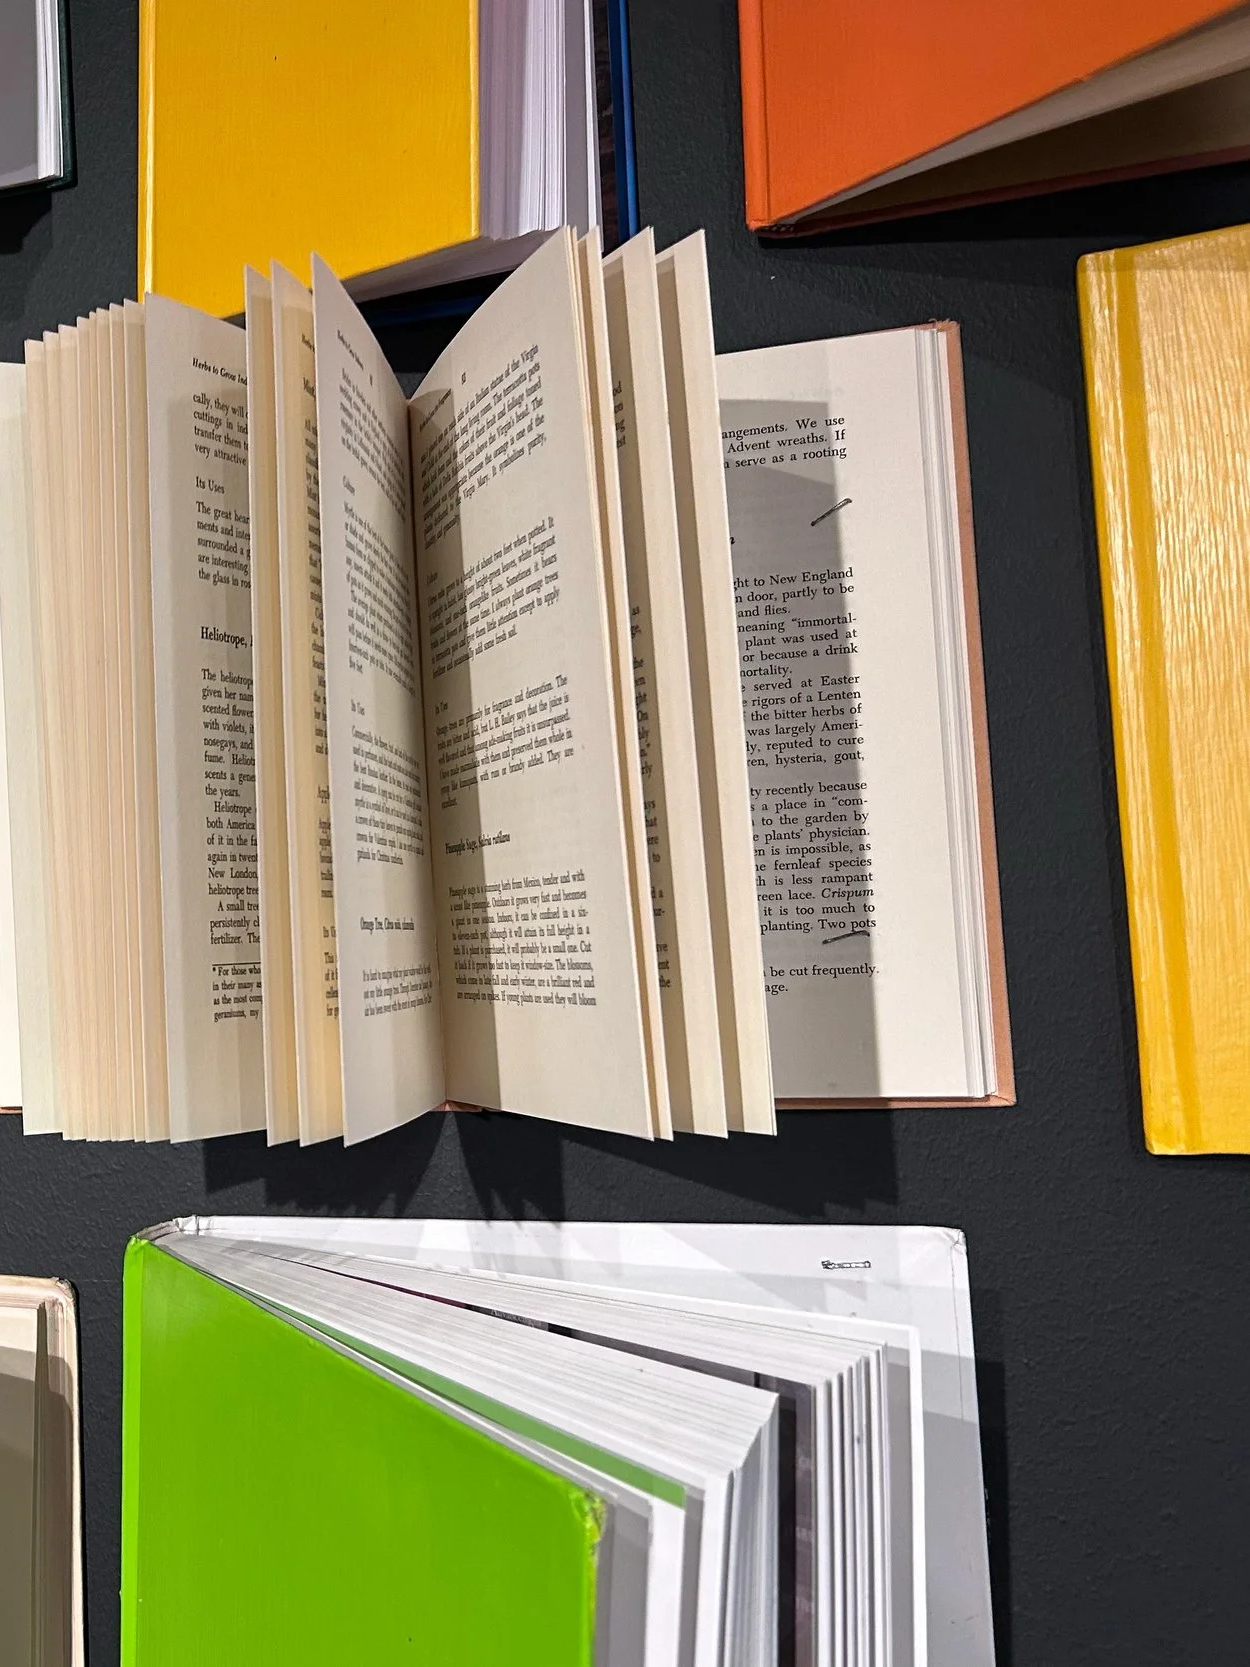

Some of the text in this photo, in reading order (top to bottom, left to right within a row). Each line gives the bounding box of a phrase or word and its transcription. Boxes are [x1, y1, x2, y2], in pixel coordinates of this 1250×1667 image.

[193, 357, 211, 372] Herbs
[214, 399, 229, 417] they
[231, 407, 244, 417] will
[194, 411, 233, 429] cuttings in
[796, 416, 845, 430] We use
[195, 426, 241, 448] transfer them
[727, 430, 845, 454] Advent wreaths. If
[195, 443, 246, 466] very attractive
[735, 447, 846, 467] serve as rooting
[196, 476, 225, 494] Its Uses
[196, 501, 232, 521] The great
[197, 521, 233, 536] ments and
[197, 537, 237, 554] surrounded
[198, 554, 248, 576] are interesting
[198, 569, 239, 586] the glass in
[754, 567, 853, 587] to New England
[747, 584, 854, 603] door, partly to be
[737, 605, 791, 617] and flies.
[201, 626, 247, 648] Heliotrope,
[745, 629, 857, 650] plant was used at
[743, 644, 858, 662] or because drink
[202, 668, 216, 681] The
[753, 675, 860, 691] served at Easter
[202, 686, 236, 700] given her
[752, 690, 861, 708] rigors of Lenten
[202, 704, 230, 716] scented
[751, 704, 862, 721] the bitter herbs of
[203, 720, 247, 734] with violets,
[748, 721, 863, 737] was largely Ameri-
[204, 738, 253, 753] nosegays, and
[767, 737, 864, 755] reputed to cure
[204, 751, 225, 763] fume.
[776, 751, 864, 765] hysteria, gout,
[205, 770, 227, 780] scents
[205, 784, 240, 800] the years.
[766, 782, 867, 797] recently because
[214, 801, 252, 818] Heliotrope
[775, 800, 807, 812] place
[814, 798, 826, 807] in
[206, 817, 223, 829] both
[762, 812, 868, 827] to the garden by
[207, 834, 248, 846] of it in the
[809, 828, 870, 841] physician.
[771, 843, 871, 855] is impossible, as
[208, 851, 236, 866] again in
[774, 858, 872, 871] fernleaf species
[208, 867, 225, 879] New
[774, 873, 873, 886] is less rampant
[209, 884, 244, 899] heliotrope
[789, 888, 874, 901] lace. Crispum
[217, 900, 244, 912] A small
[764, 903, 875, 915] it is too much to
[210, 917, 250, 932] persistently
[761, 919, 876, 935] planting. Two pots
[211, 932, 243, 944] fertilizer.
[218, 967, 246, 976] For those
[771, 963, 879, 979] be cut frequently.
[213, 981, 254, 992] in their many
[213, 995, 247, 1005] as the most
